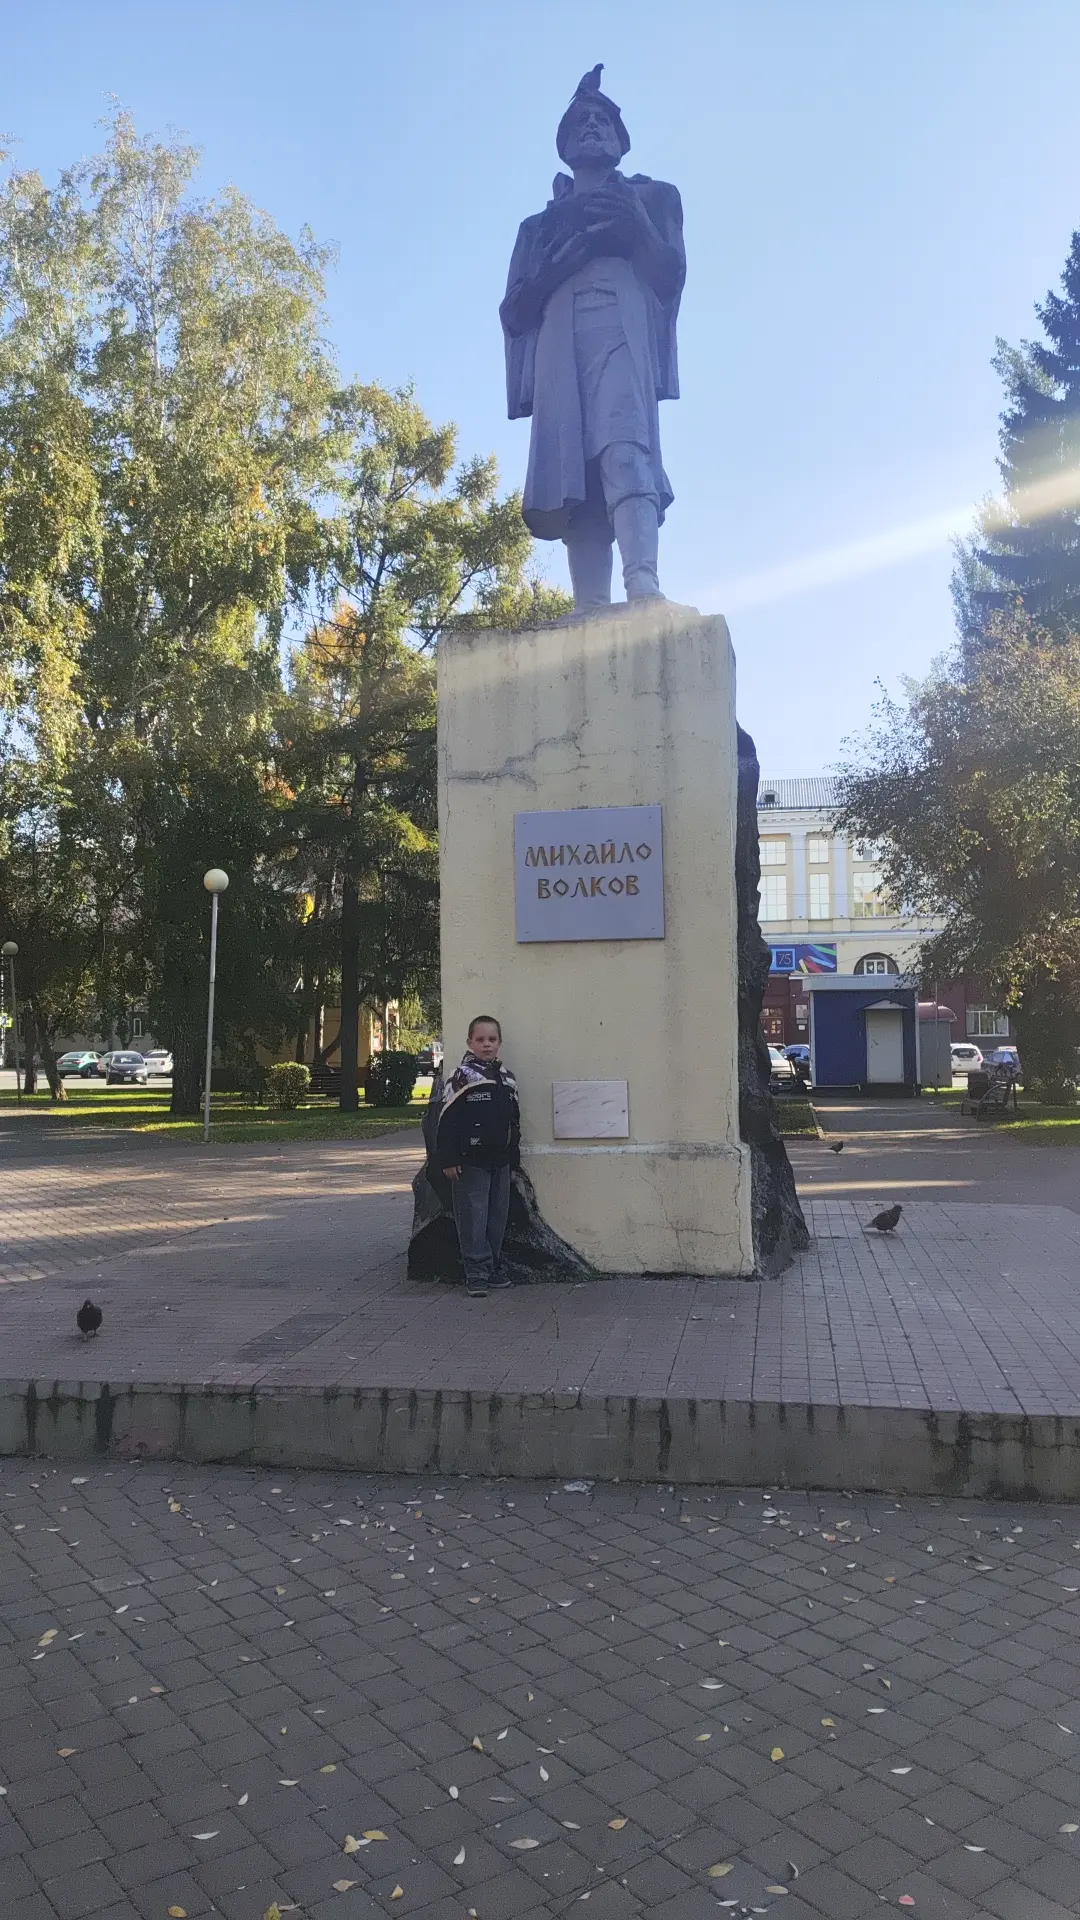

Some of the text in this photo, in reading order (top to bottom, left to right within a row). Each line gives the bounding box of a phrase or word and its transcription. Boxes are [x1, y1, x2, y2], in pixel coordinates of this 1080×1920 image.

[525, 838, 652, 867] МИХАЙЛО
[537, 875, 641, 899] ВОЛКОВ
[778, 953, 791, 965] 75
